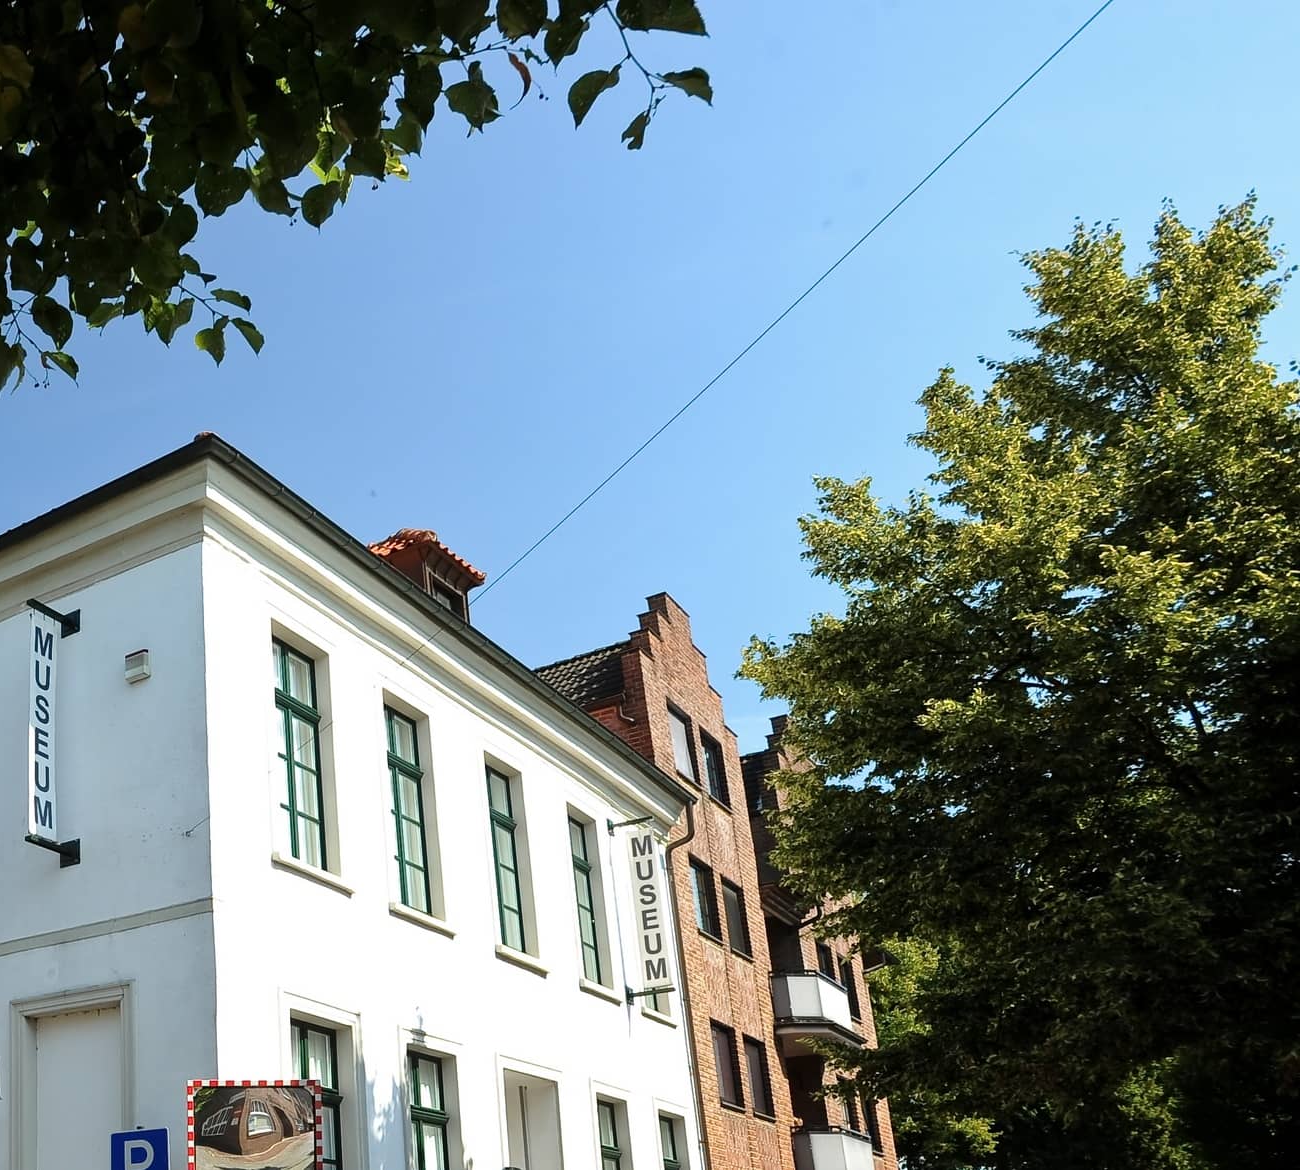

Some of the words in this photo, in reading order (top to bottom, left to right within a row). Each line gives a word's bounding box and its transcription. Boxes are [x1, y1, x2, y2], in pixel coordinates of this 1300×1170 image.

[34, 626, 54, 829] MUSEUM
[630, 835, 668, 981] MUSEUM
[124, 1140, 154, 1170] P
